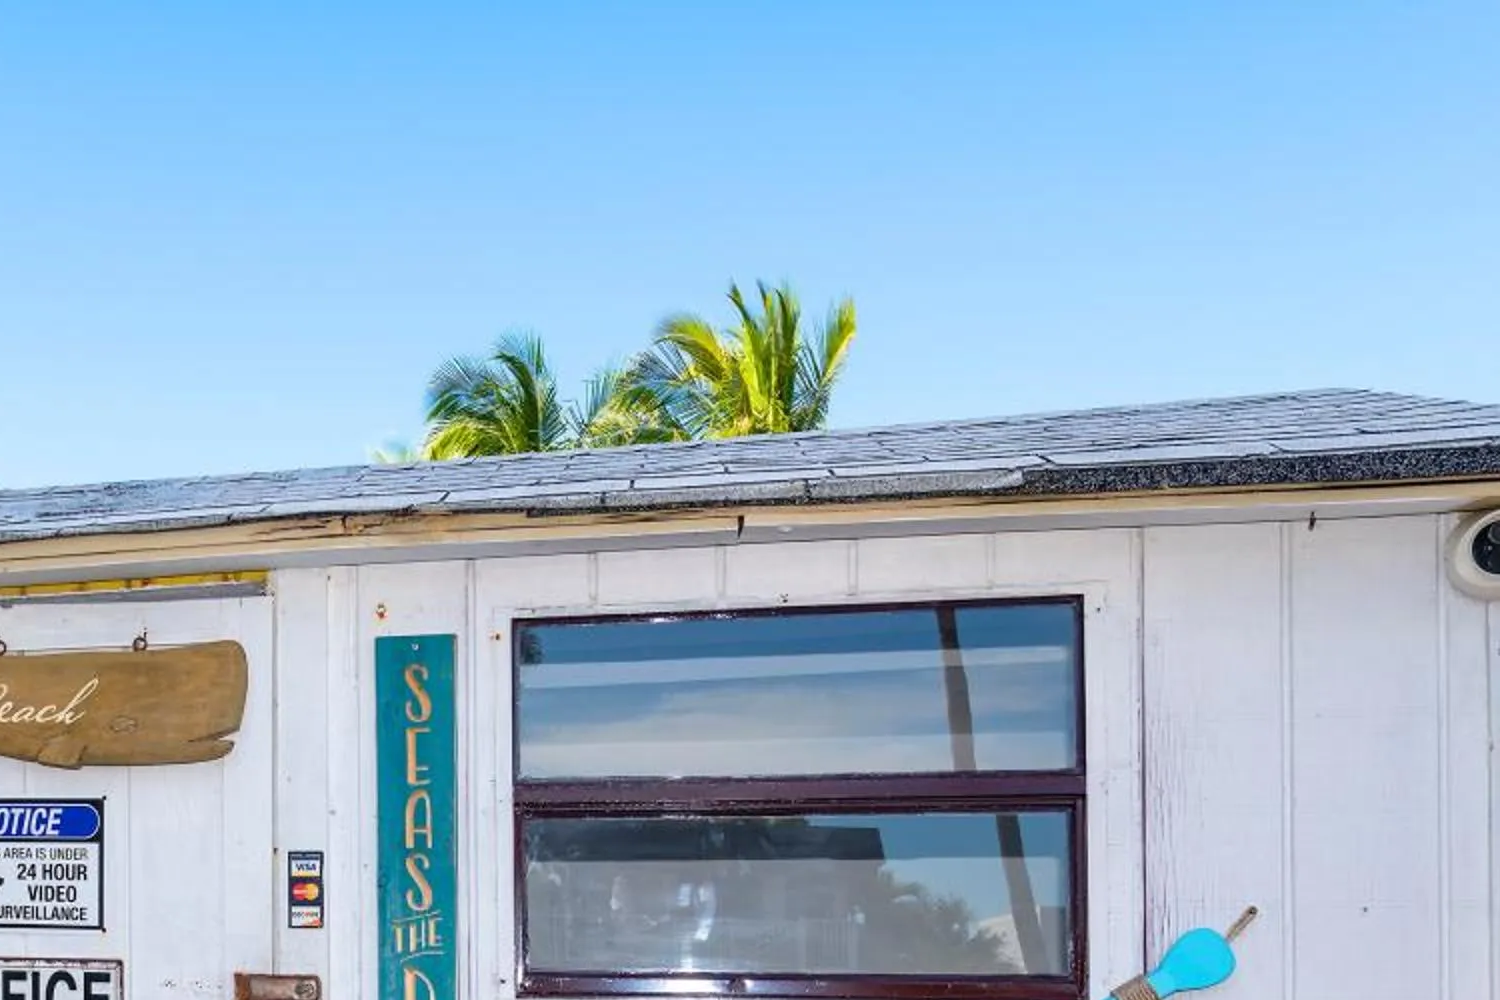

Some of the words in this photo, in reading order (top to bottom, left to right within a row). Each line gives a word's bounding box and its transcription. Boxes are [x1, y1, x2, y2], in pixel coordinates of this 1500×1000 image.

[404, 663, 432, 912] SEAS
[3, 848, 32, 859] AREA
[36, 848, 47, 860] IS
[50, 848, 88, 861] UNDER
[17, 864, 37, 881] 24
[42, 864, 88, 881] HOUR
[27, 885, 77, 902] VIDEO
[394, 916, 443, 952] THE
